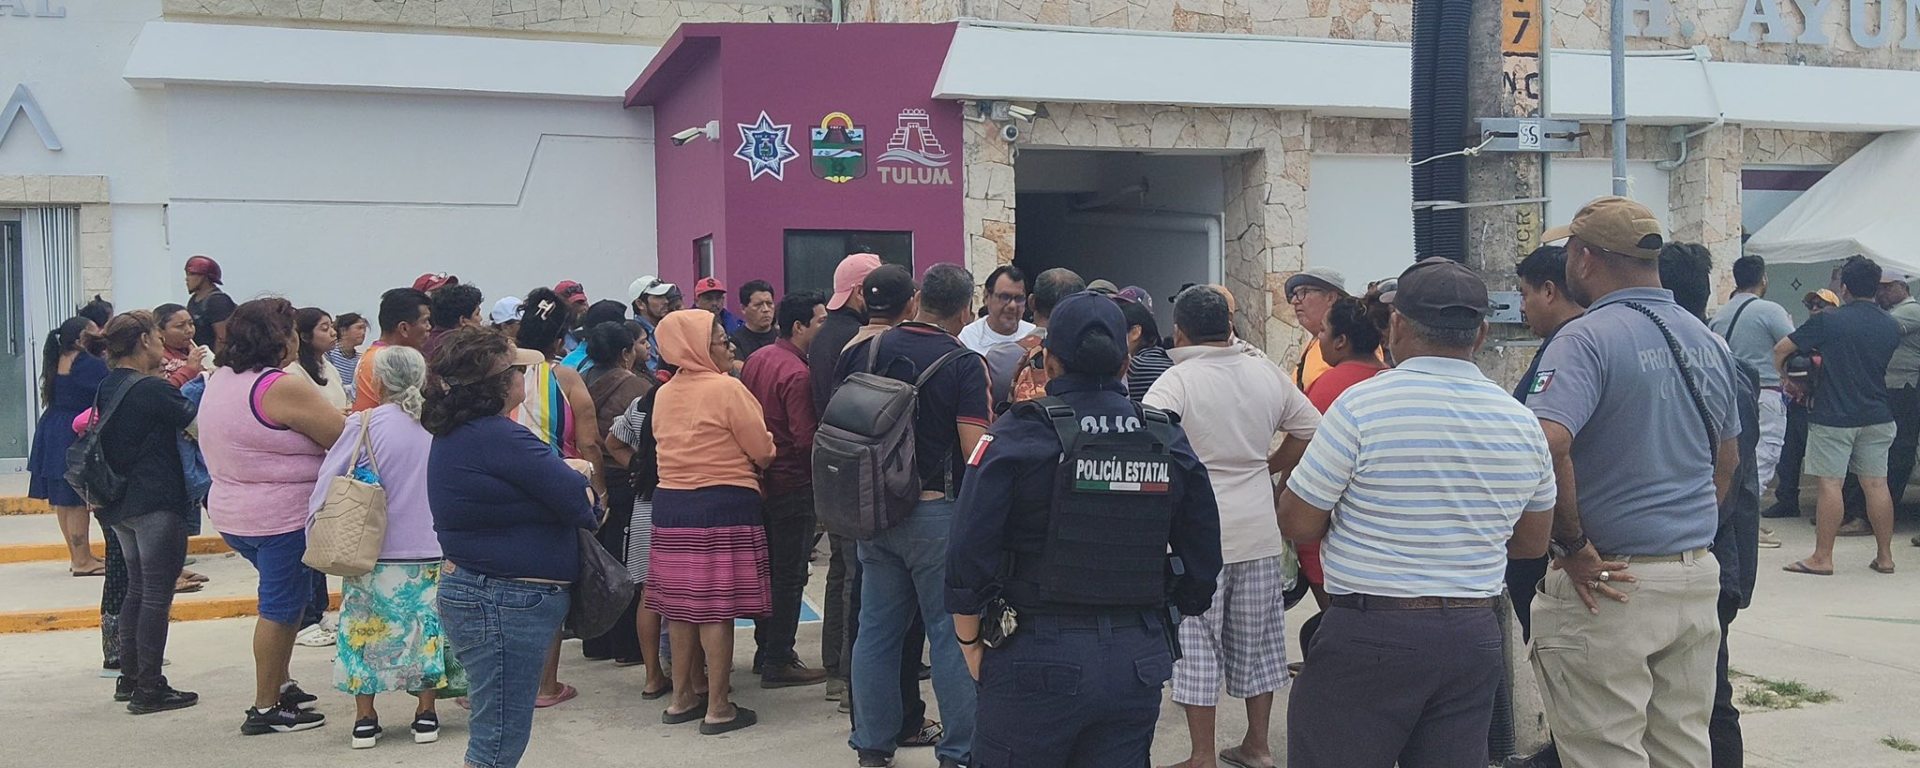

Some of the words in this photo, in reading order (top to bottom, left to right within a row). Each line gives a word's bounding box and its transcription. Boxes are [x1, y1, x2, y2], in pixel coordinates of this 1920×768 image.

[1728, 0, 1920, 49] AYU
[877, 167, 952, 184] TULUM
[1076, 456, 1122, 481] POLICÍA
[1125, 461, 1170, 483] ESTATAL
